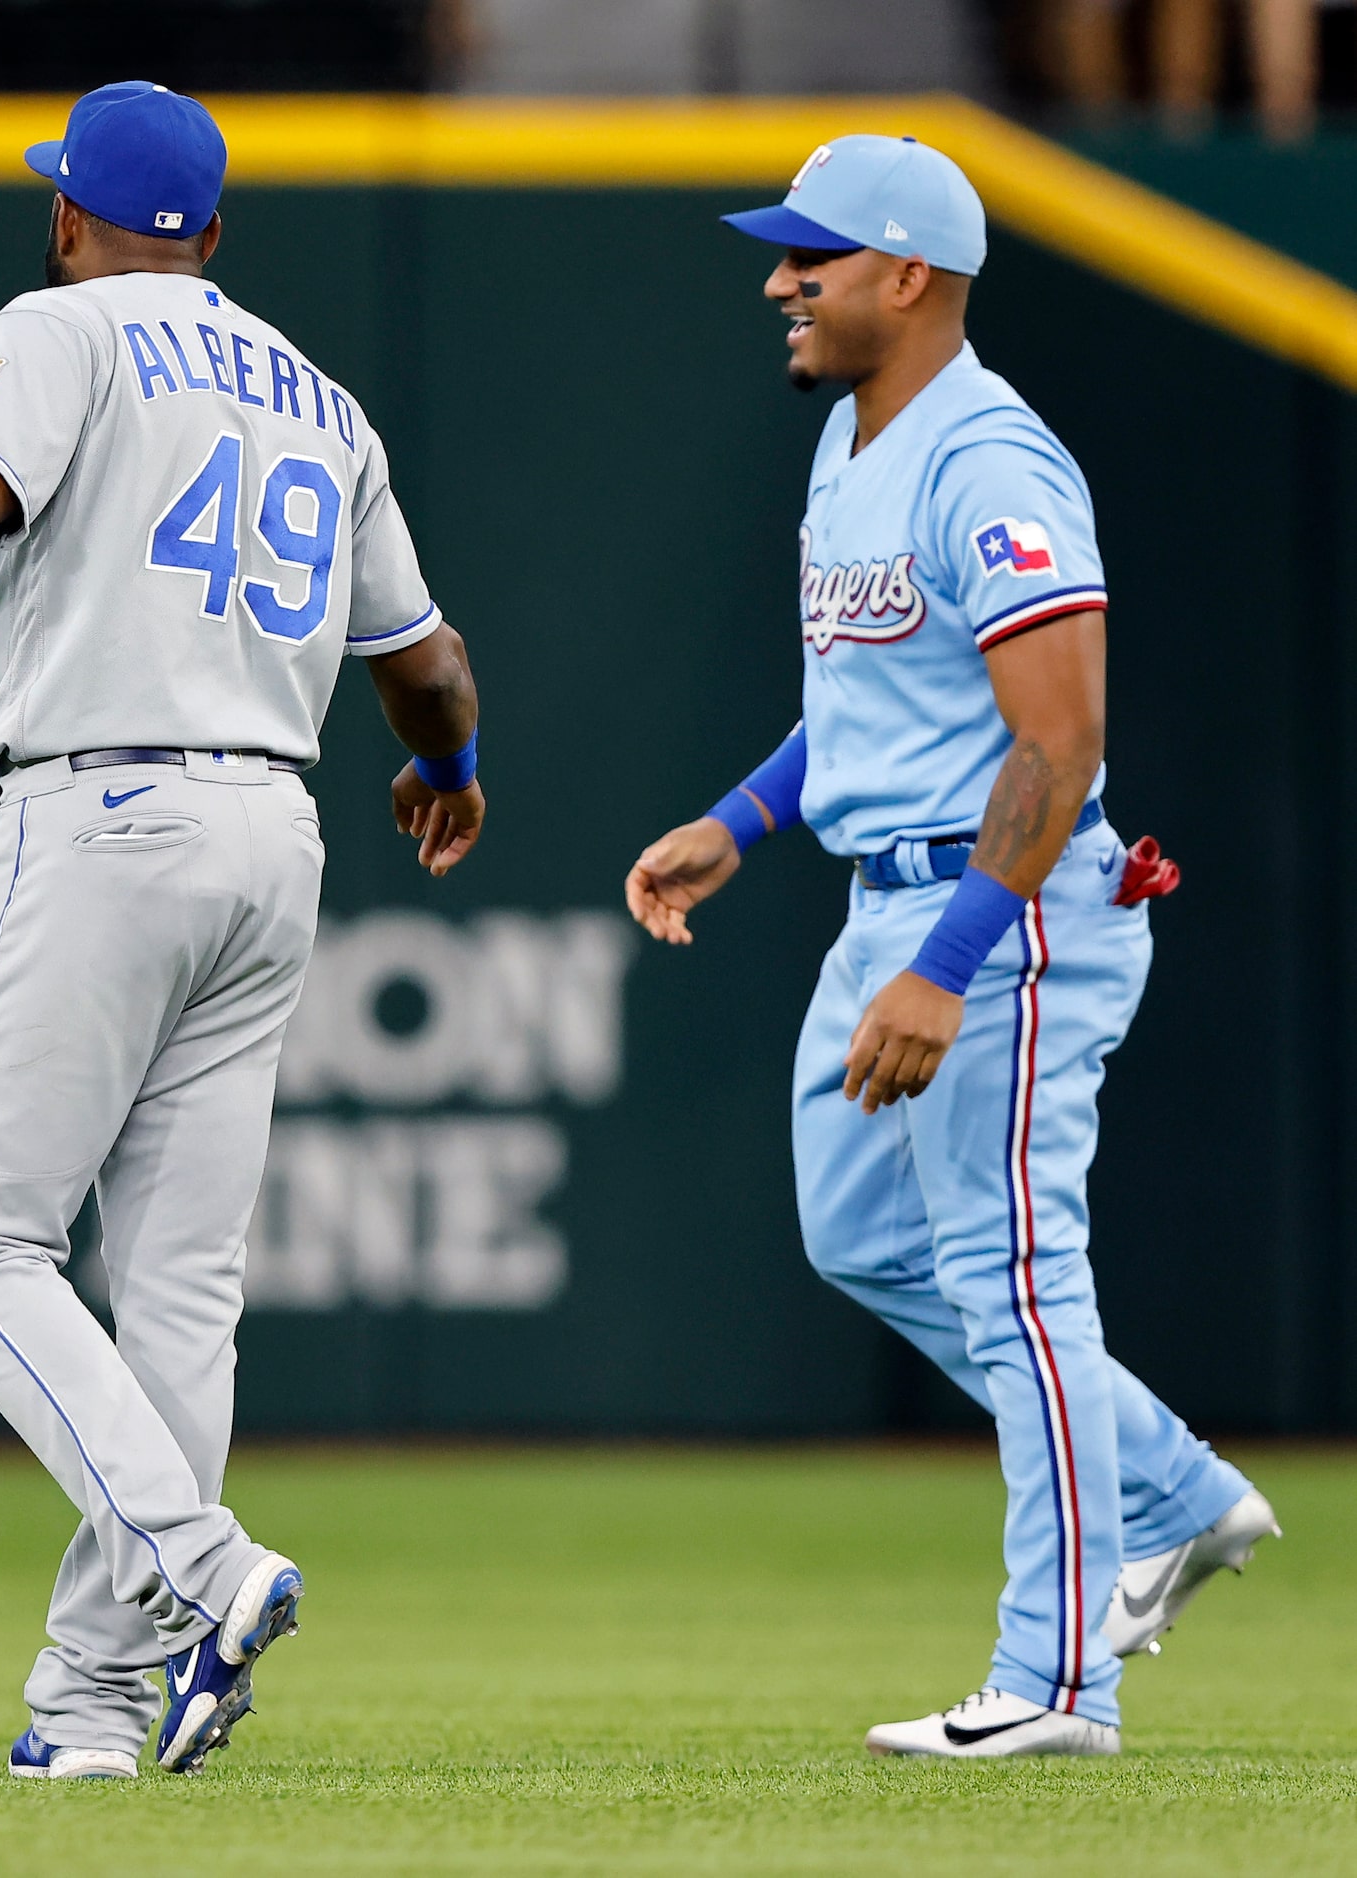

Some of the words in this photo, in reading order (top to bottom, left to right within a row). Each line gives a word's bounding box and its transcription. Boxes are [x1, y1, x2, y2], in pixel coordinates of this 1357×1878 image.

[119, 318, 356, 455] ALBERTO
[145, 429, 346, 648] 49
[799, 524, 927, 656] ngers
